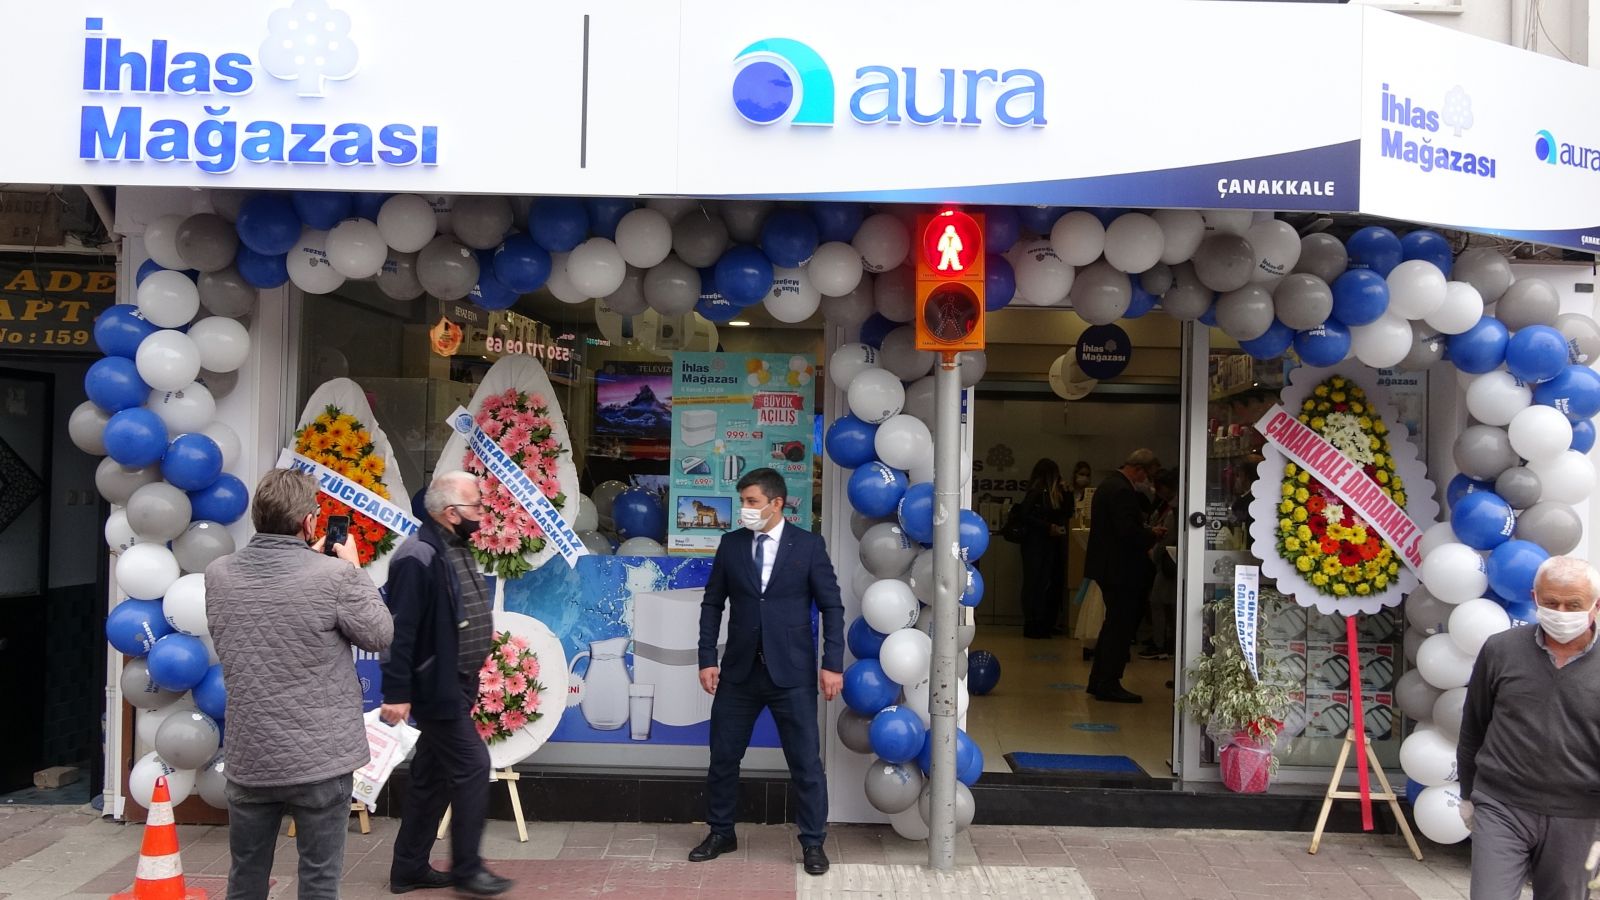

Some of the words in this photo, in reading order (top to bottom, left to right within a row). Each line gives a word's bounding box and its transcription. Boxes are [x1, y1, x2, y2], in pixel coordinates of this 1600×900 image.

[82, 17, 255, 94] İhlas
[849, 64, 1048, 128] aura
[1381, 83, 1439, 132] İhlas
[79, 105, 440, 174] Mağazası
[1381, 127, 1496, 178] Mağazası
[1217, 178, 1335, 199] ÇANAKKALE
[42, 329, 89, 345] 159
[682, 361, 710, 373] İhlas
[682, 374, 738, 385] Mağazası
[1377, 377, 1418, 387] ağazası
[760, 409, 796, 424] AÇILIŞ
[763, 395, 793, 407] BÜYÜK
[1264, 411, 1354, 486] ÇANAKKALE
[1340, 470, 1417, 549] DARDANEL
[490, 462, 534, 509] BELEDİYE
[532, 509, 574, 558] BAŞKANI
[537, 496, 583, 552] PALAZ
